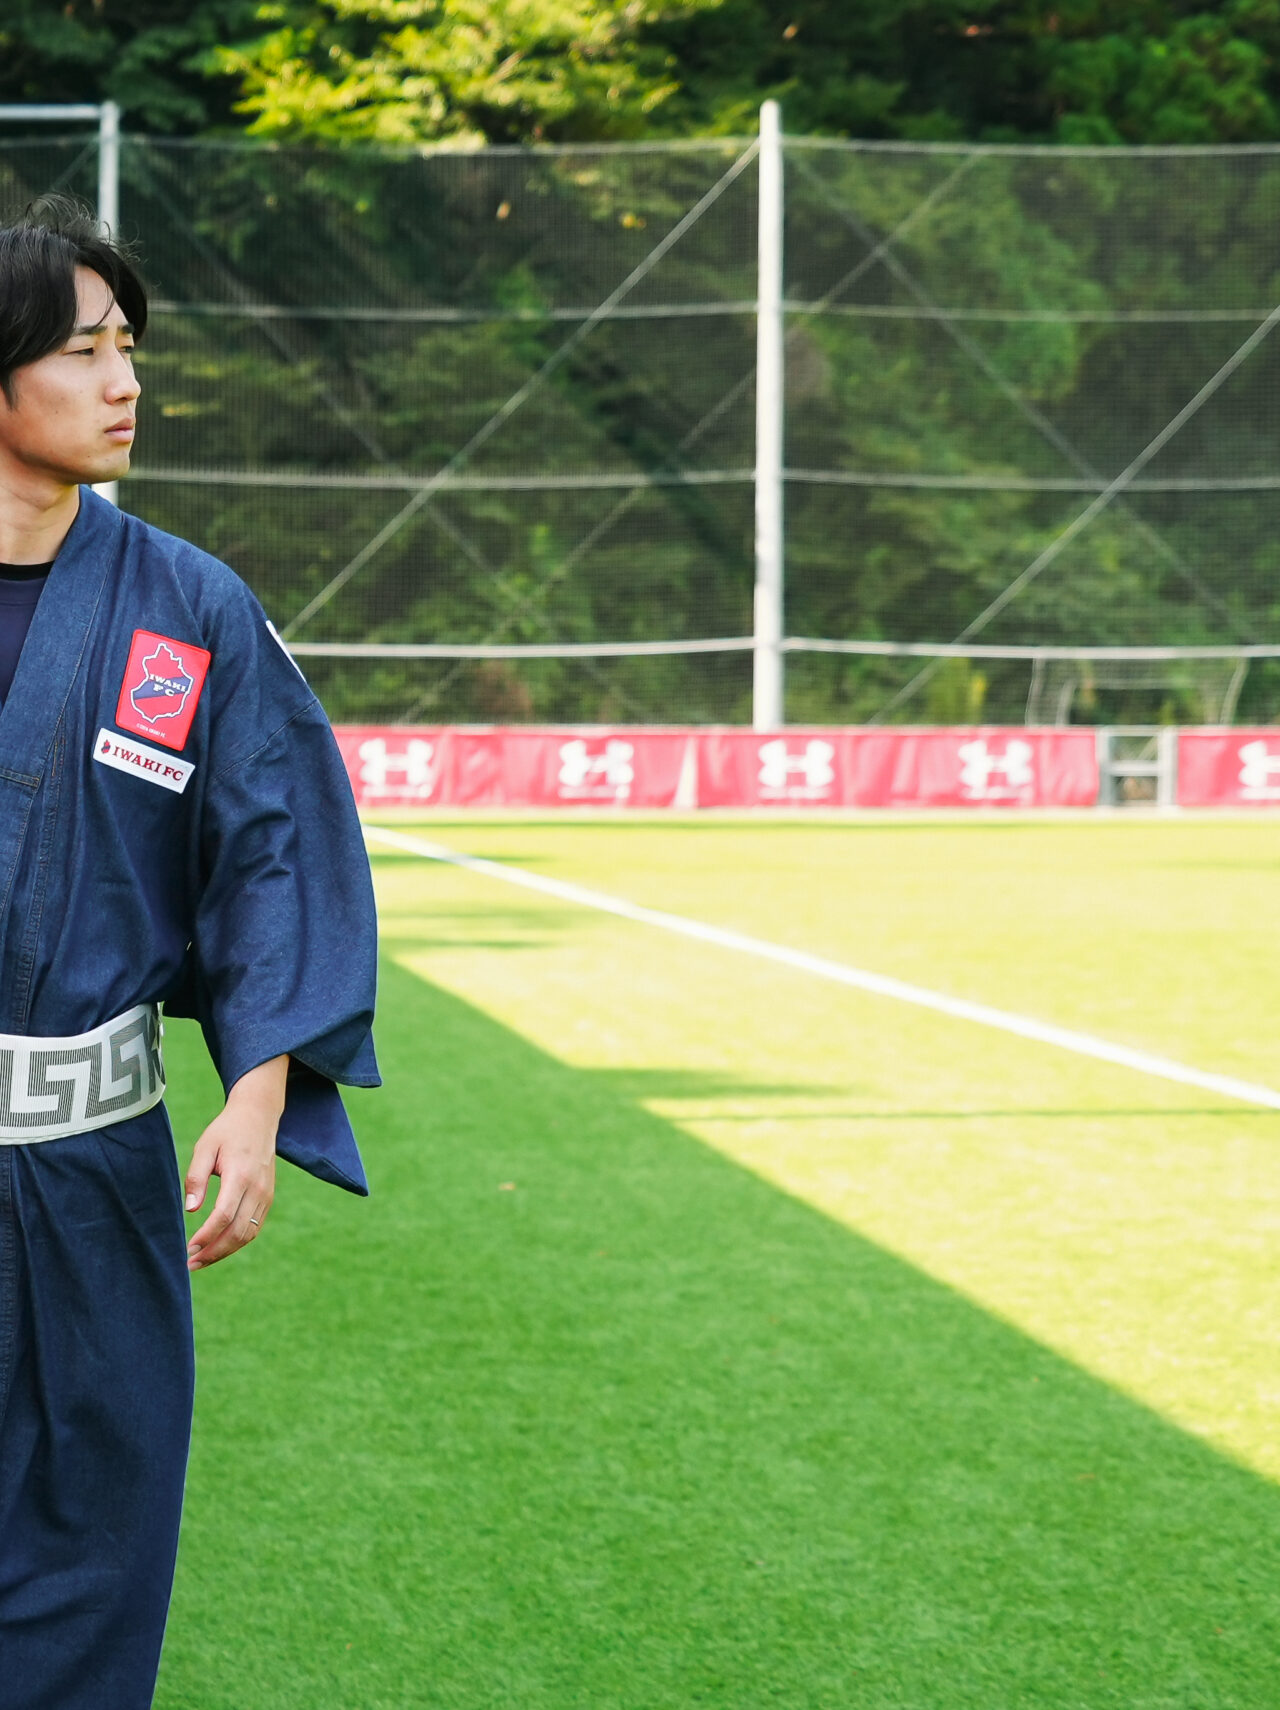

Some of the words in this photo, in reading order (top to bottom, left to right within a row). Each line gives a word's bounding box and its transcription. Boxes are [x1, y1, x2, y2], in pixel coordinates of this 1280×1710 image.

[150, 674, 186, 692] IWAKI
[153, 683, 175, 697] FC
[113, 746, 162, 773] IWAKI
[162, 766, 184, 781] FC
